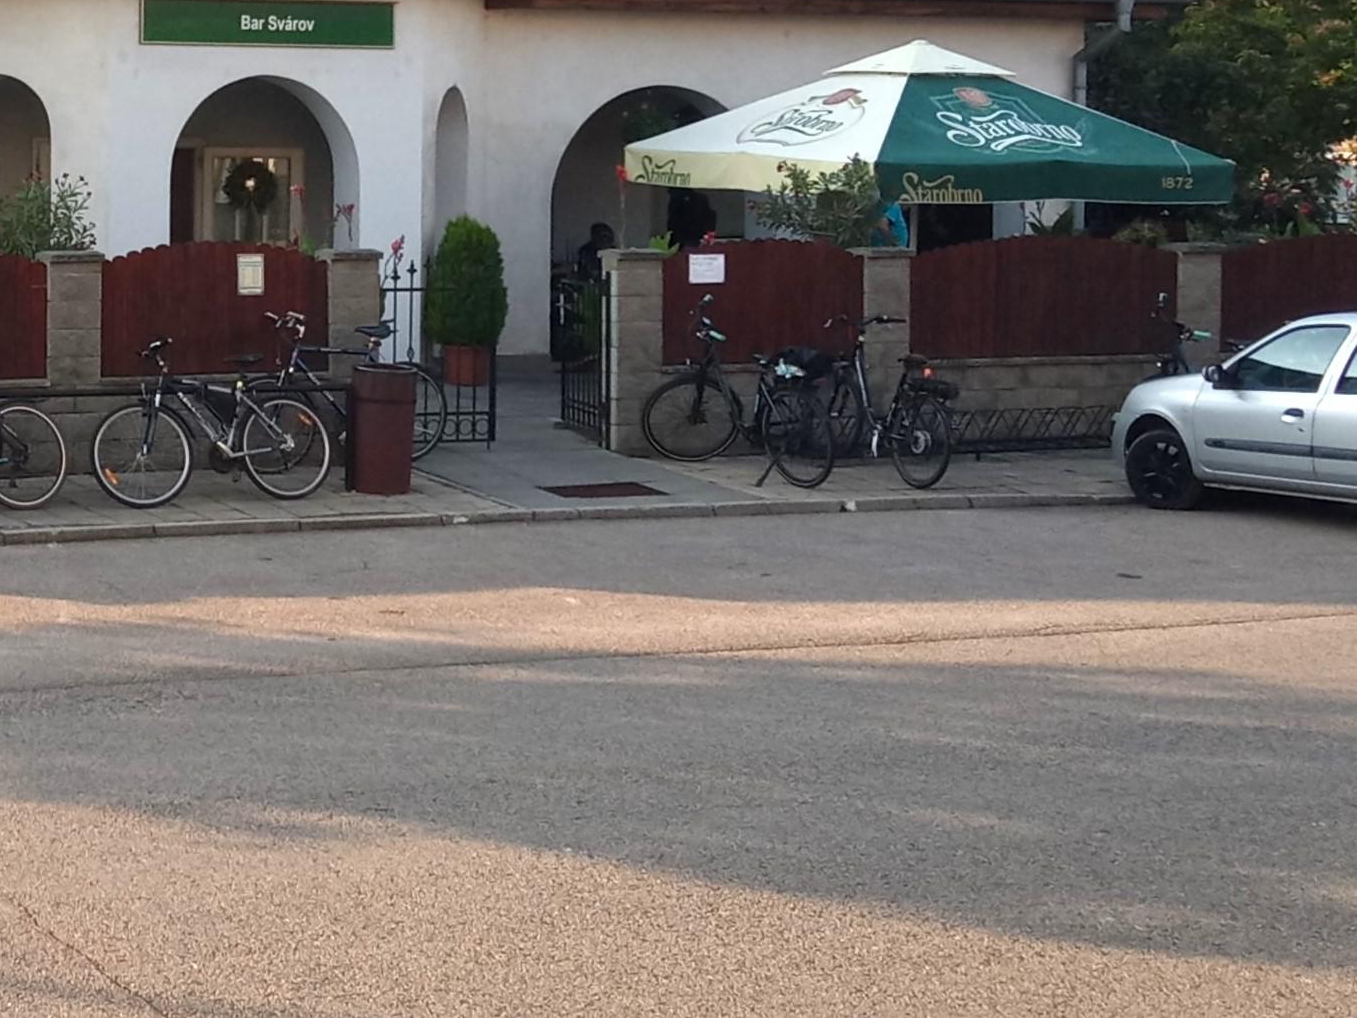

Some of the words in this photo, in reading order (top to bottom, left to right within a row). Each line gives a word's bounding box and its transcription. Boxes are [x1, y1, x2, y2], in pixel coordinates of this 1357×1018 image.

[240, 14, 264, 31] Bar
[267, 14, 315, 32] Svárov
[936, 109, 1083, 151] Starobrno
[898, 172, 983, 203] Starobrno
[1162, 177, 1194, 189] 1872
